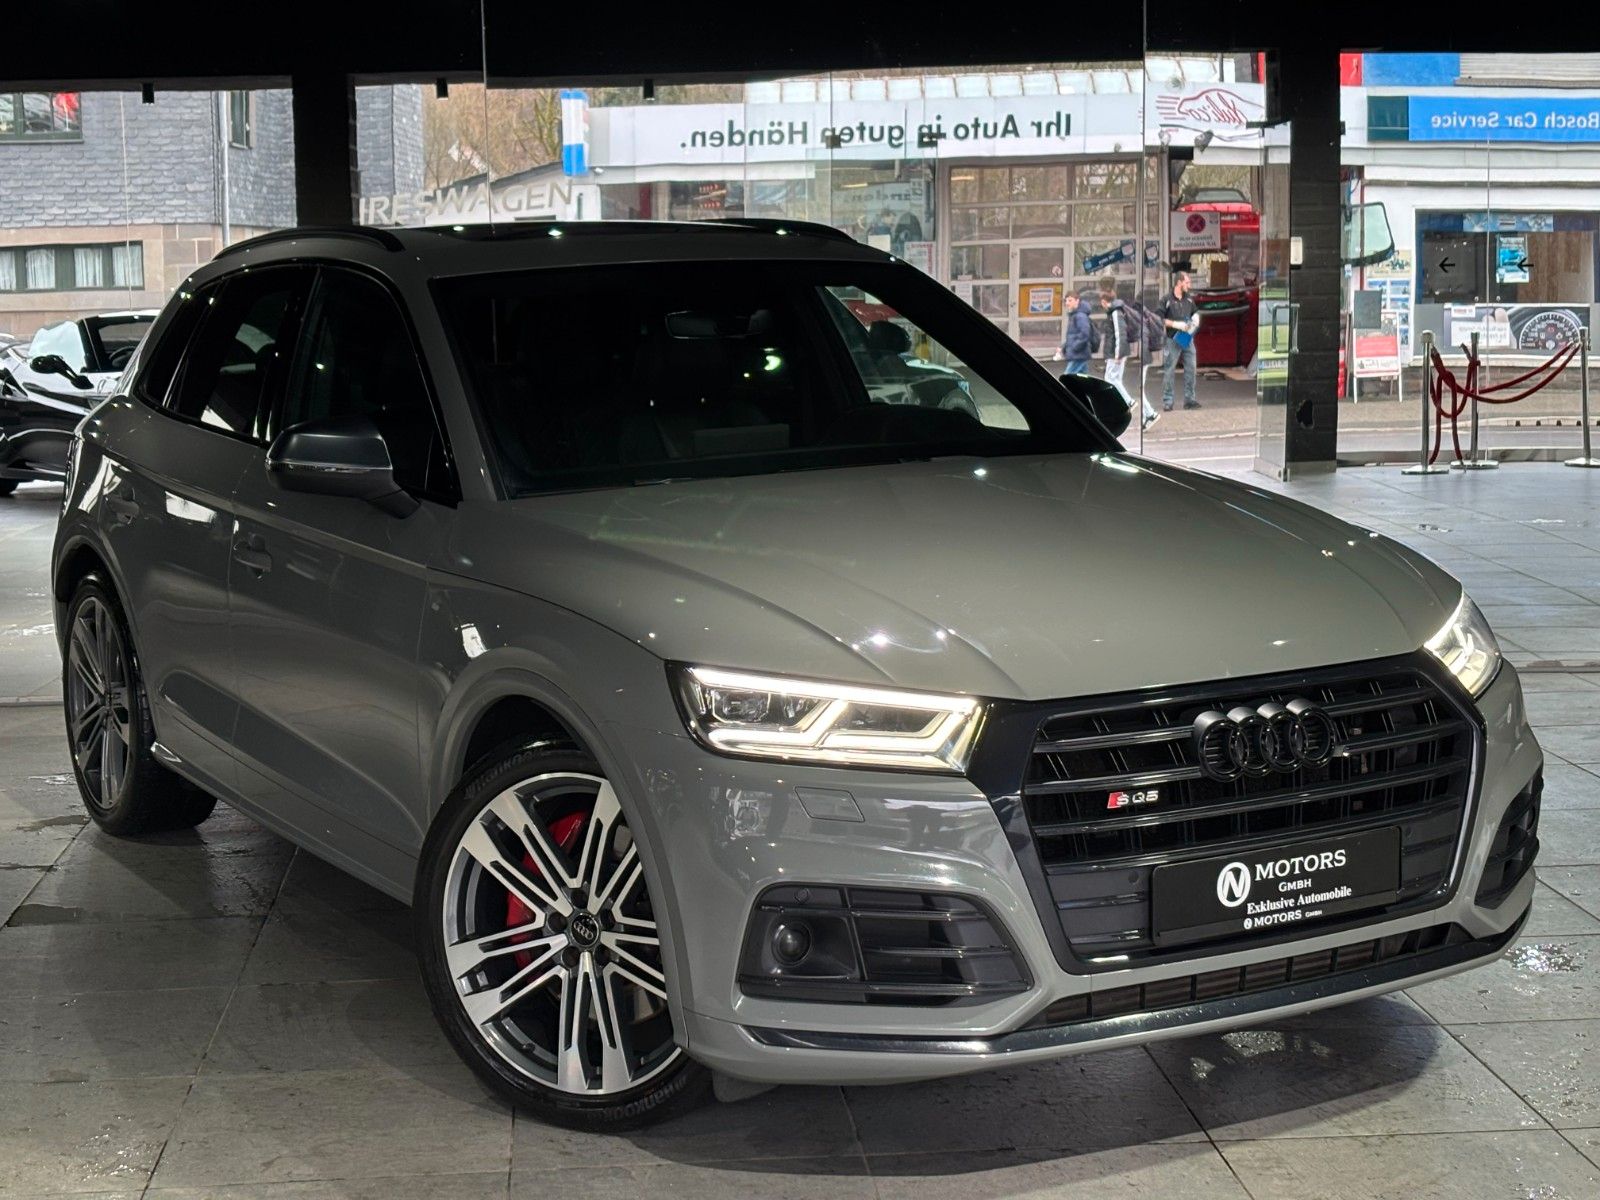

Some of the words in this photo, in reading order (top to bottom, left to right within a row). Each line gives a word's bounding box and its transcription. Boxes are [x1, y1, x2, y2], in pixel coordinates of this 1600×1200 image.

[1107, 789, 1159, 809] SQ5
[1255, 849, 1346, 881] MOTORS
[1278, 878, 1312, 892] GMBH
[1246, 898, 1295, 915] Exklusive
[1297, 885, 1352, 907] Automobile
[1254, 910, 1302, 928] MOTORS
